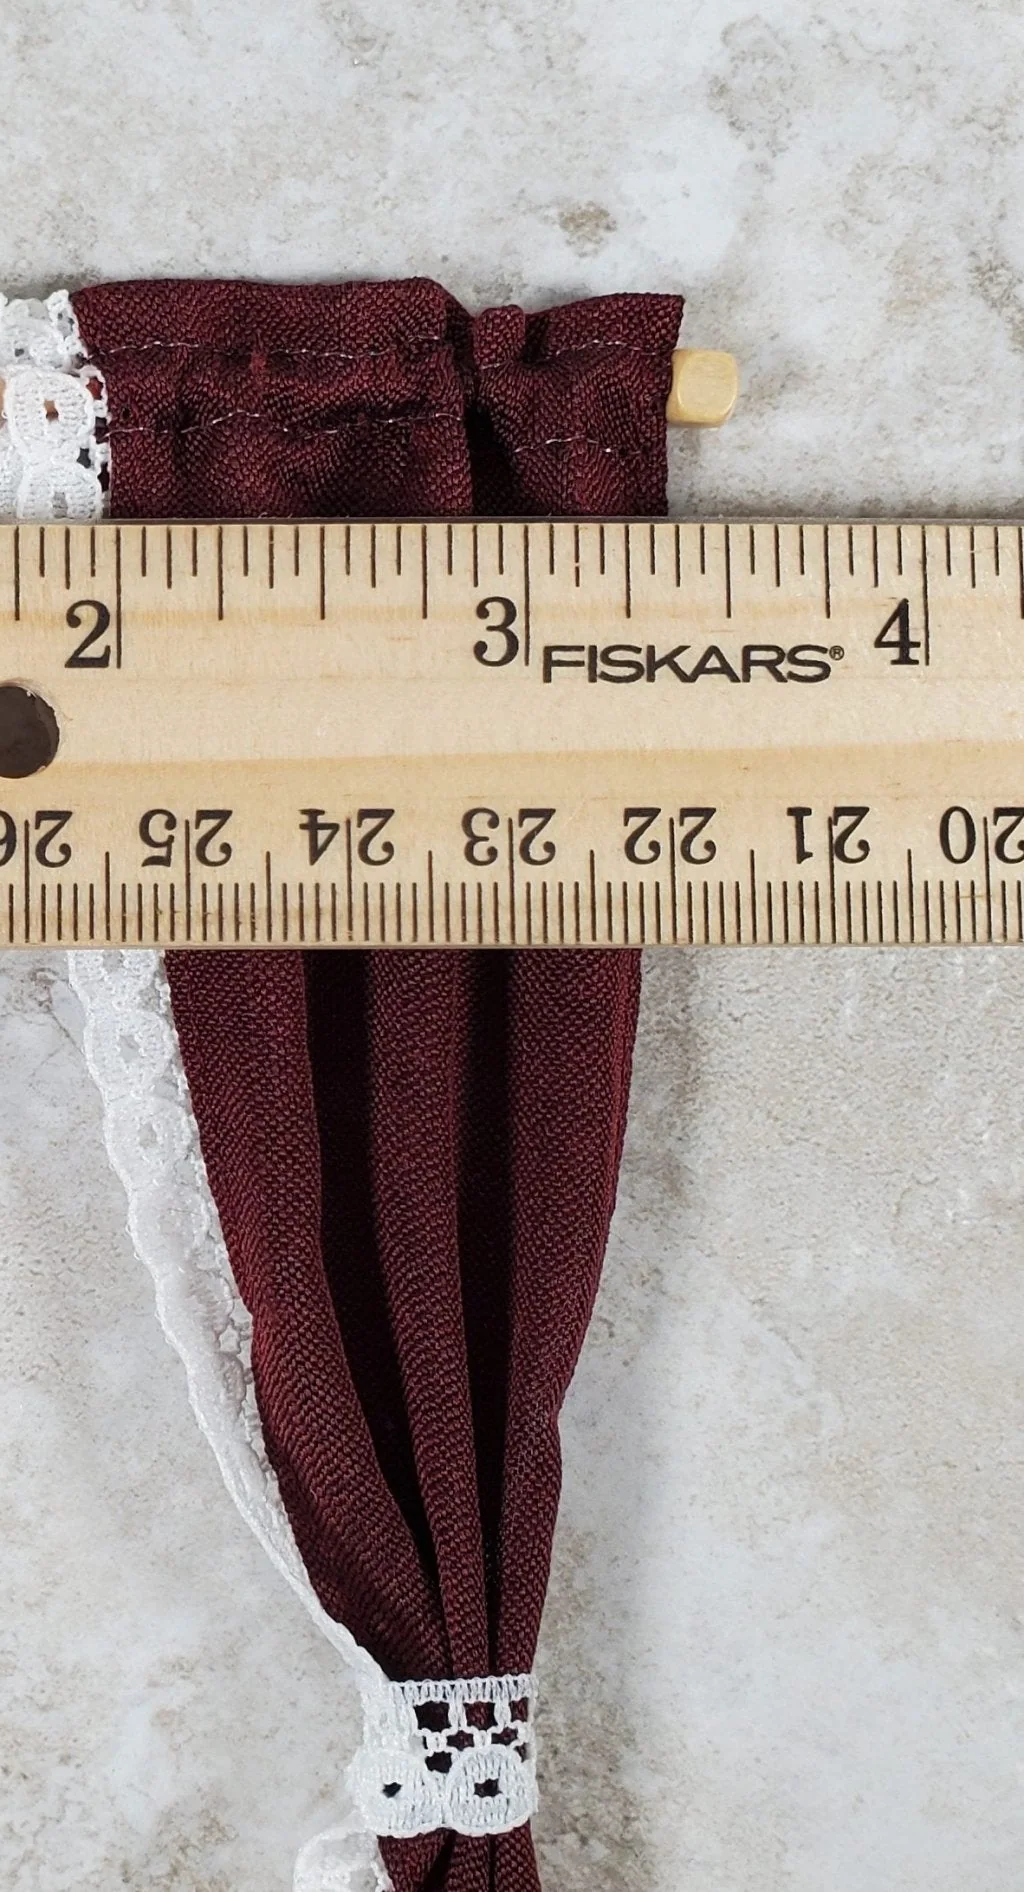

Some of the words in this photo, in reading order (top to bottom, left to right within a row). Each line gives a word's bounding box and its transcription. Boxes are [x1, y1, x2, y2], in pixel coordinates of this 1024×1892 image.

[64, 599, 112, 669] 2
[473, 596, 520, 667] 3
[873, 597, 922, 666] 4
[138, 808, 233, 868] 25
[298, 808, 396, 866] 24
[461, 807, 557, 867] 23
[623, 806, 717, 865] 22
[786, 806, 871, 865] 21
